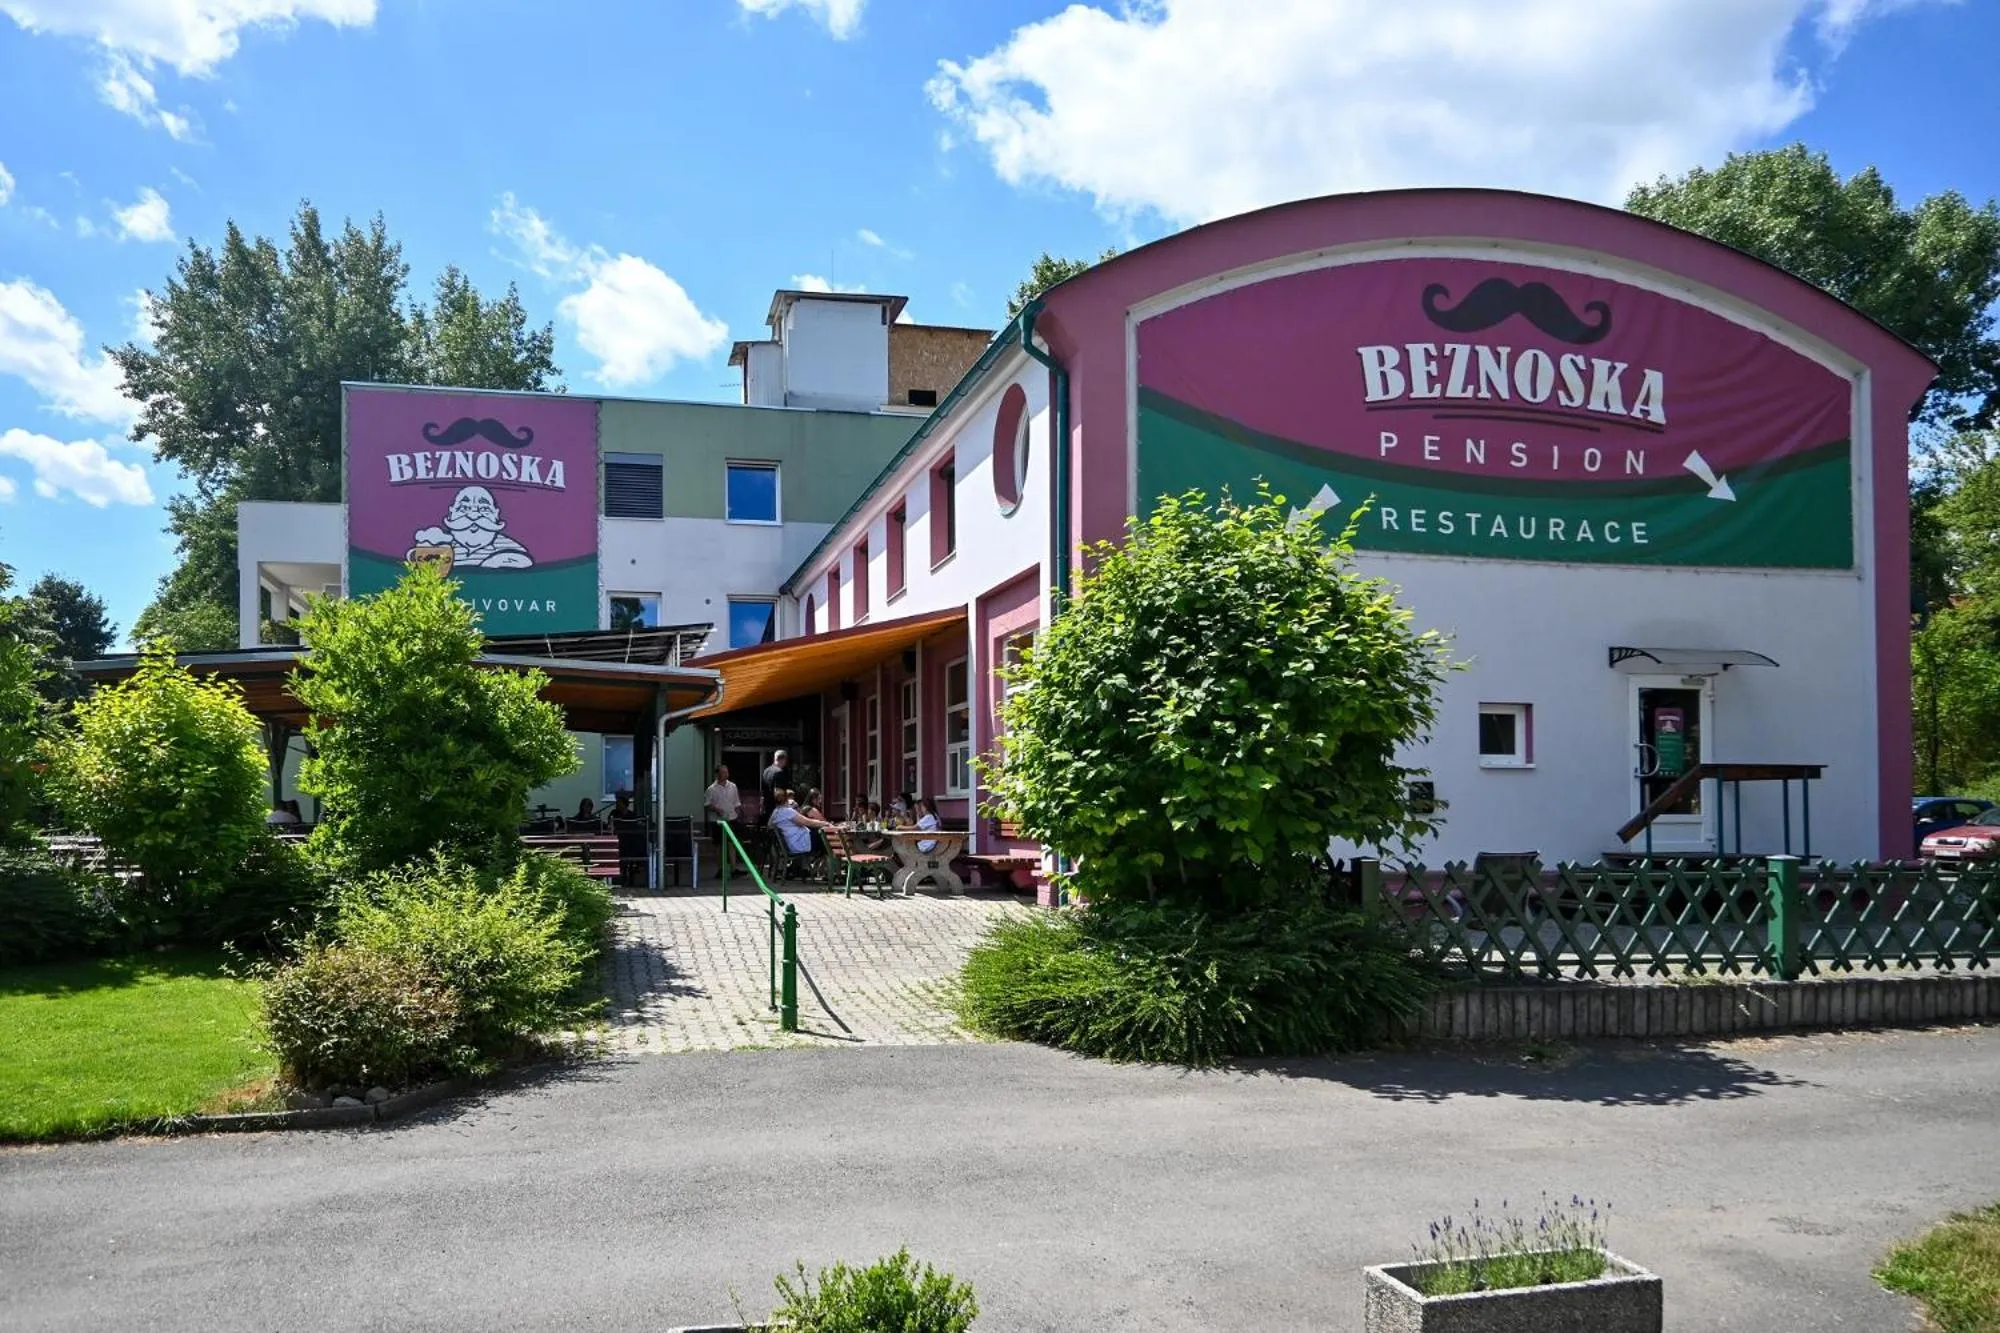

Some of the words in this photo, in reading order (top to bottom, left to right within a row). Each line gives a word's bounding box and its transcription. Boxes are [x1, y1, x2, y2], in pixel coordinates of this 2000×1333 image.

[1357, 343, 1667, 425] BEZNOSKA
[385, 451, 566, 488] BEZNOSKA
[1380, 432, 1645, 475] PENSION
[1381, 507, 1649, 544] RESTAURACE
[460, 599, 556, 612] IVOVAR
